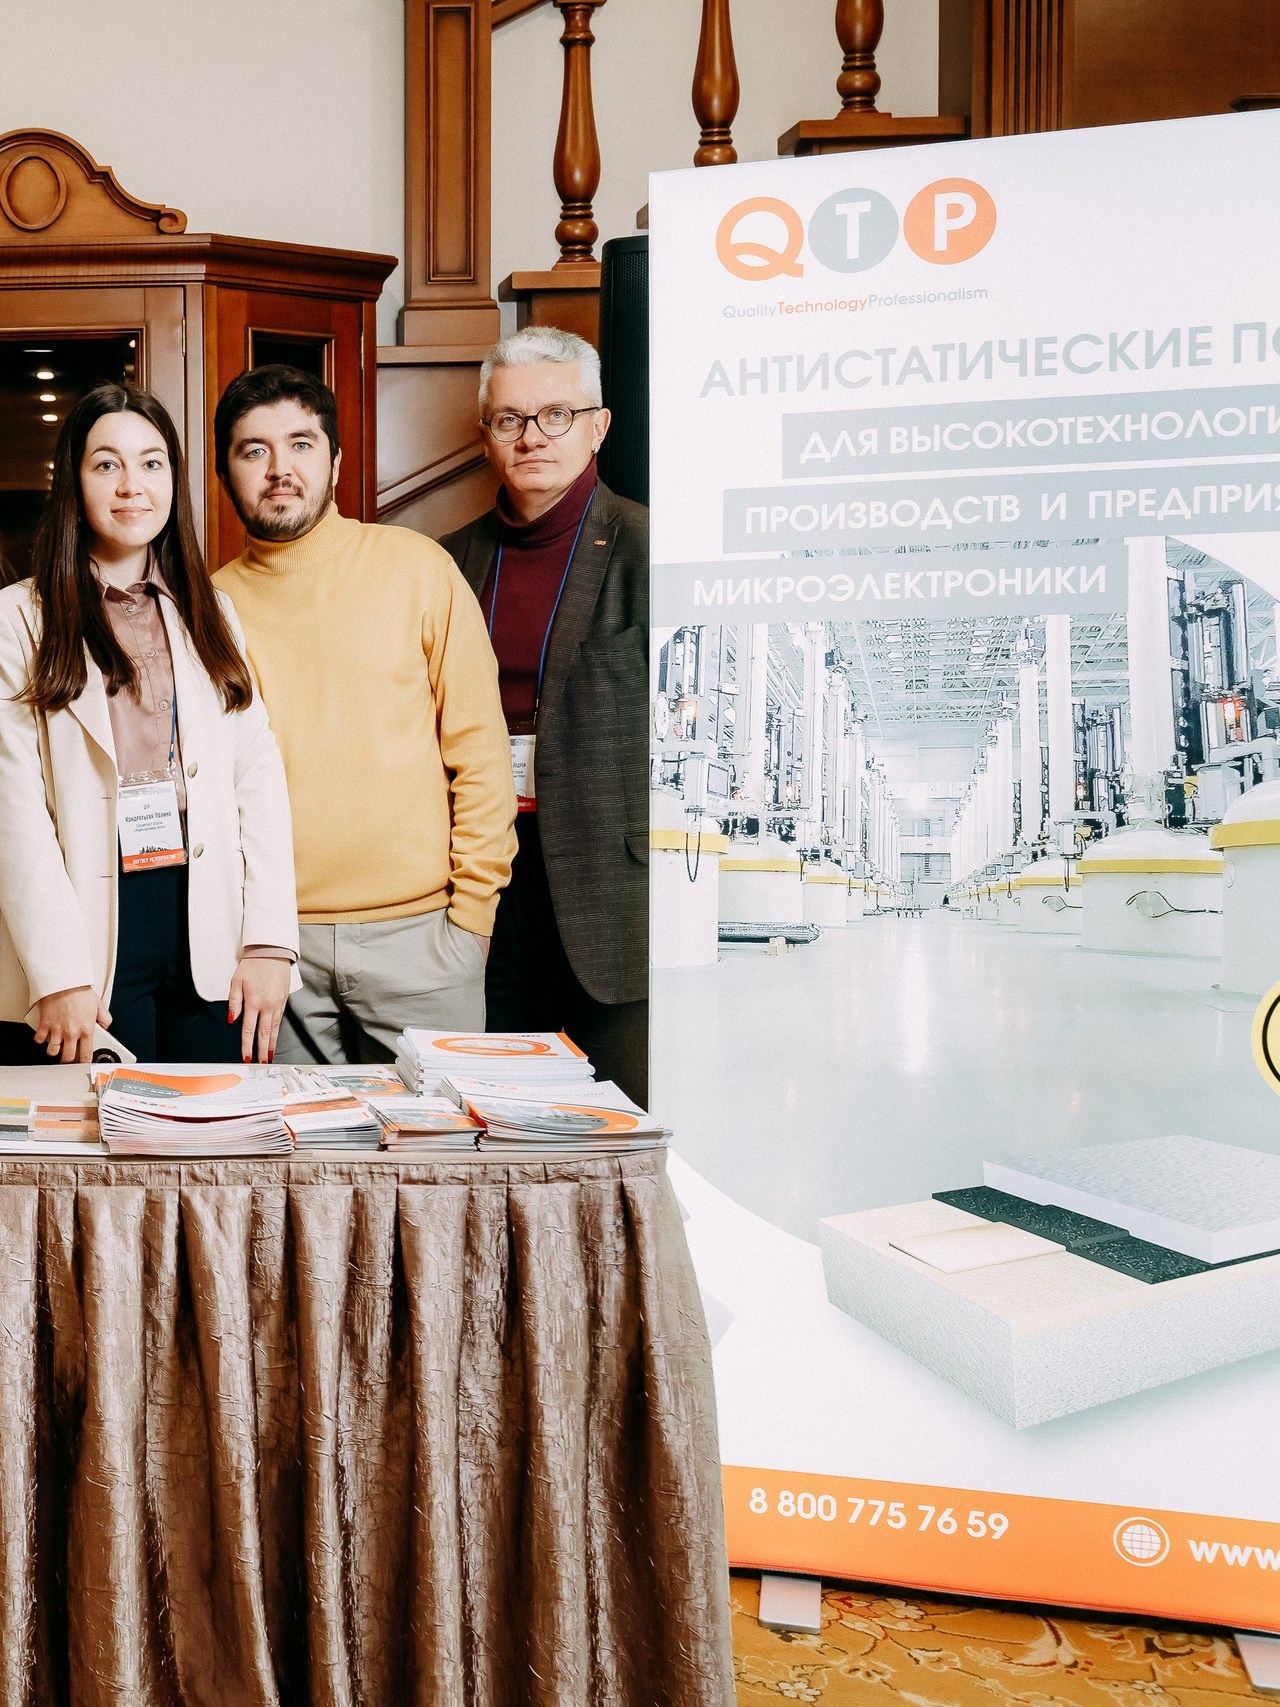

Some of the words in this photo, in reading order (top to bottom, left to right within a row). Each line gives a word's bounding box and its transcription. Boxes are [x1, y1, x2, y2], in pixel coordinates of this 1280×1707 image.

[716, 177, 997, 281] QTP
[699, 326, 1213, 399] АНТИСТАТИЧЕСКИЕ
[799, 426, 878, 465] ДЛЯ
[745, 493, 1021, 534] ПРОИЗВОДСТВ
[1041, 493, 1067, 521] И
[1088, 482, 1280, 521] ПРЕДПРИ
[693, 565, 1107, 607] МИКРОЭЛЕКТРОНИКИ
[749, 1487, 768, 1514] 8
[777, 1490, 837, 1522] 800
[847, 1496, 907, 1529] 775
[917, 1504, 958, 1535] 76
[966, 1509, 1010, 1540] 59
